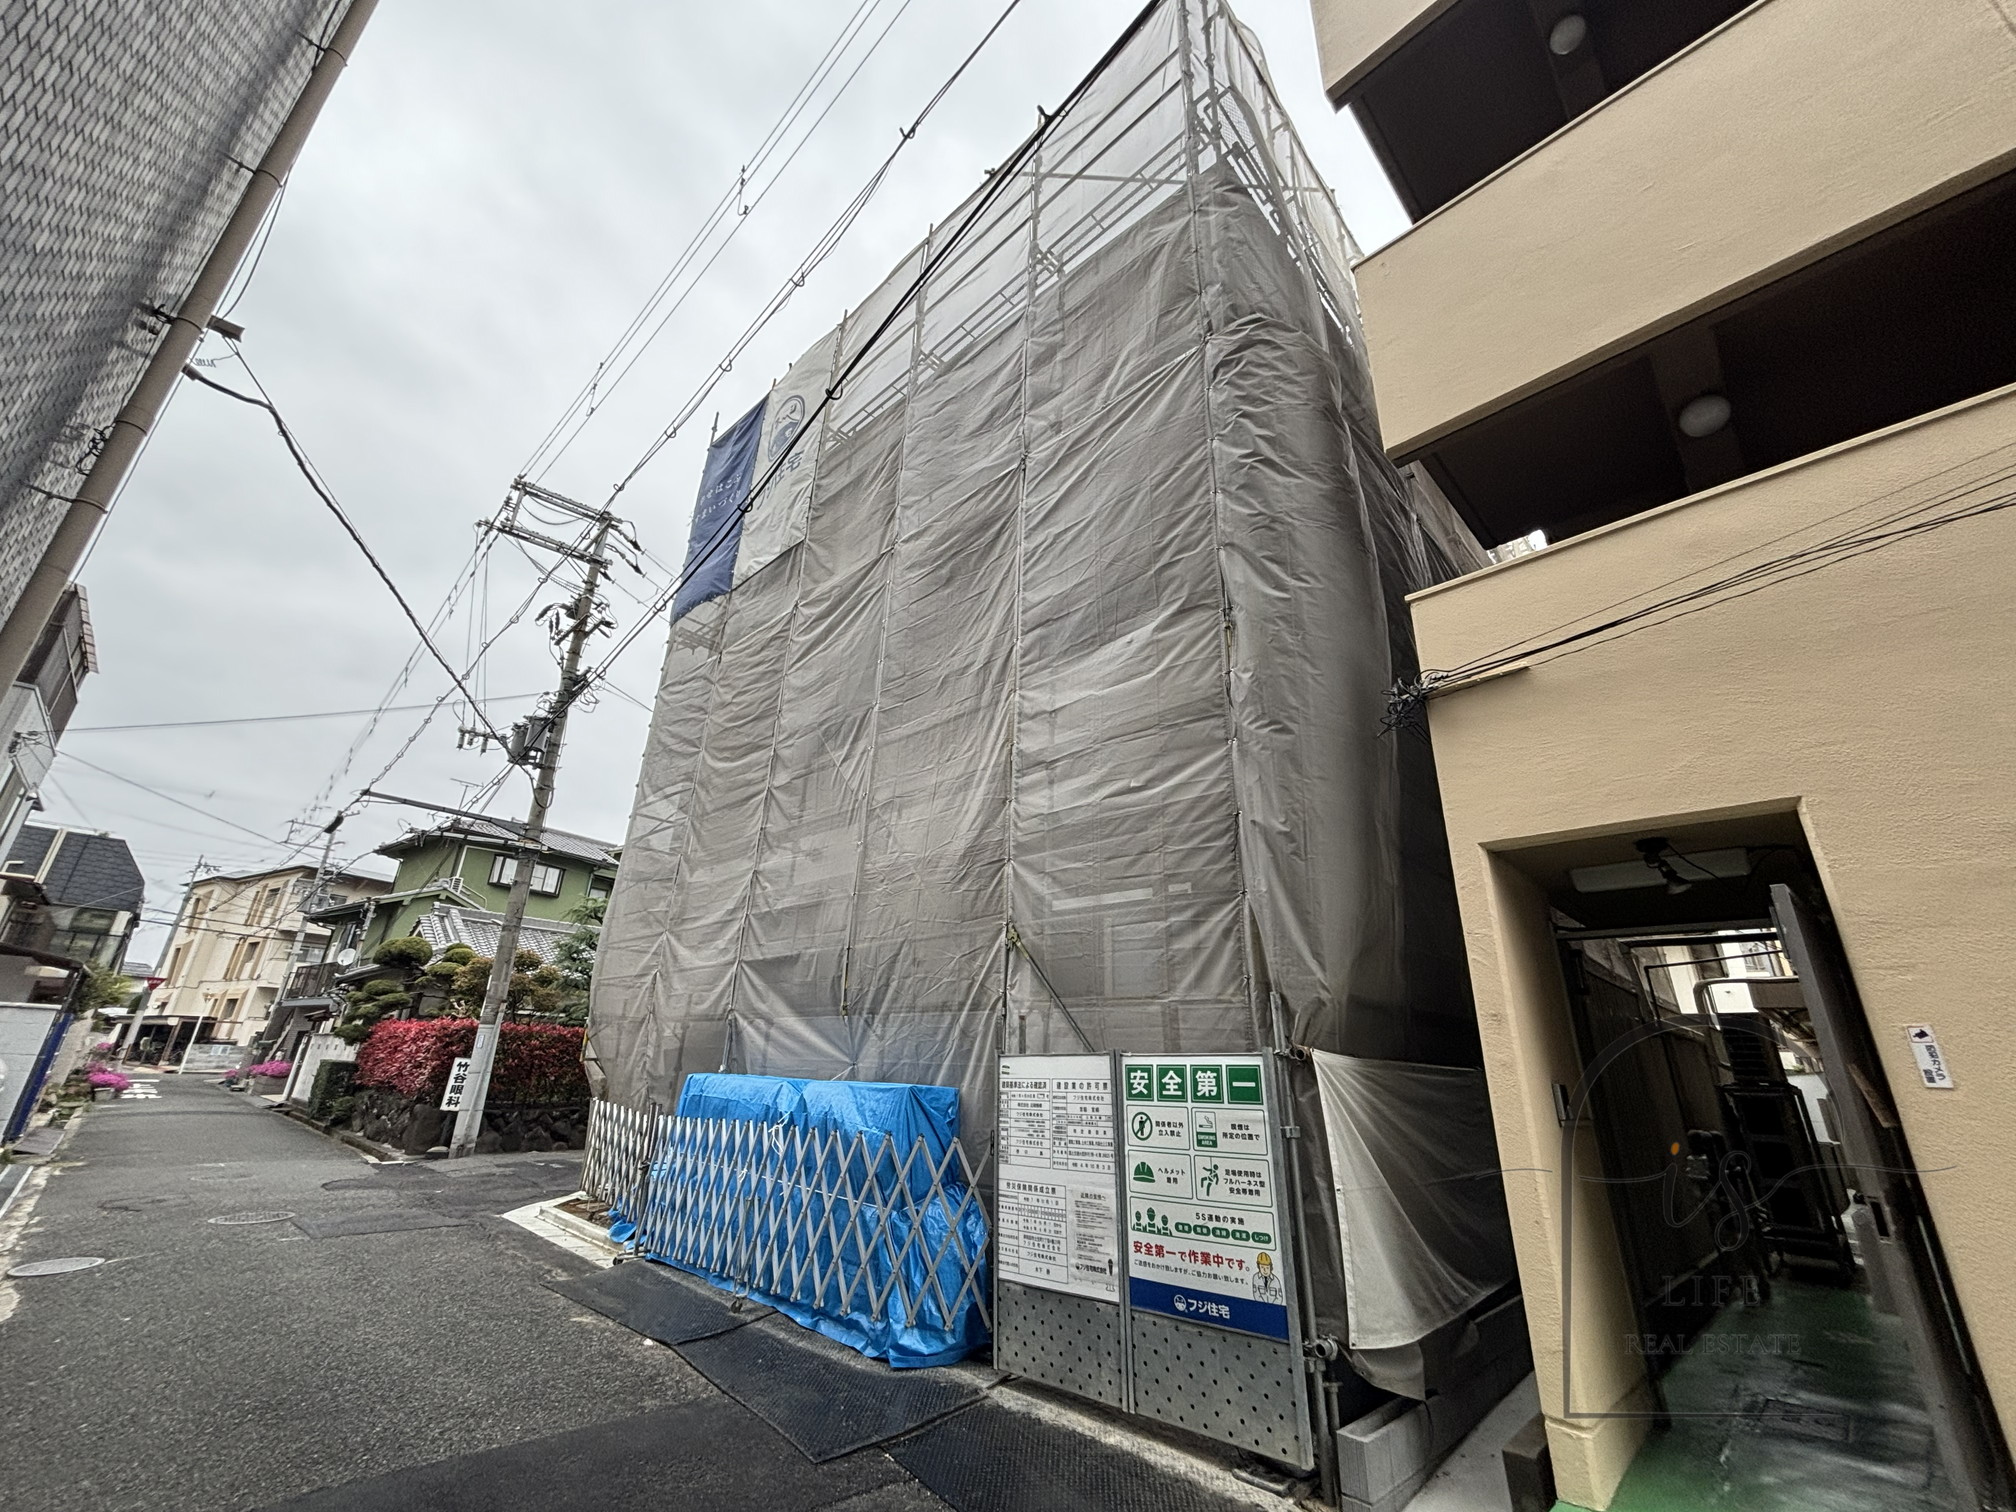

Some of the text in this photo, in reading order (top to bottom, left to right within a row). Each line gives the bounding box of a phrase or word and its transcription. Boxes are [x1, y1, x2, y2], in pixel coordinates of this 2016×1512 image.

[445, 1061, 471, 1108] 竹谷眼科
[1130, 1070, 1256, 1097] 安全第一
[1155, 1120, 1184, 1129] 関係者以外
[1158, 1129, 1182, 1138] 立入禁止
[1158, 1167, 1186, 1176] ヘルメット
[1223, 1178, 1265, 1188] フルハーネス型
[1195, 1212, 1245, 1226] 5S運動の実施
[1254, 1234, 1269, 1242] しつけ
[1133, 1240, 1250, 1272] 安全第一で作業中です。
[1187, 1298, 1231, 1320] フジ住宅
